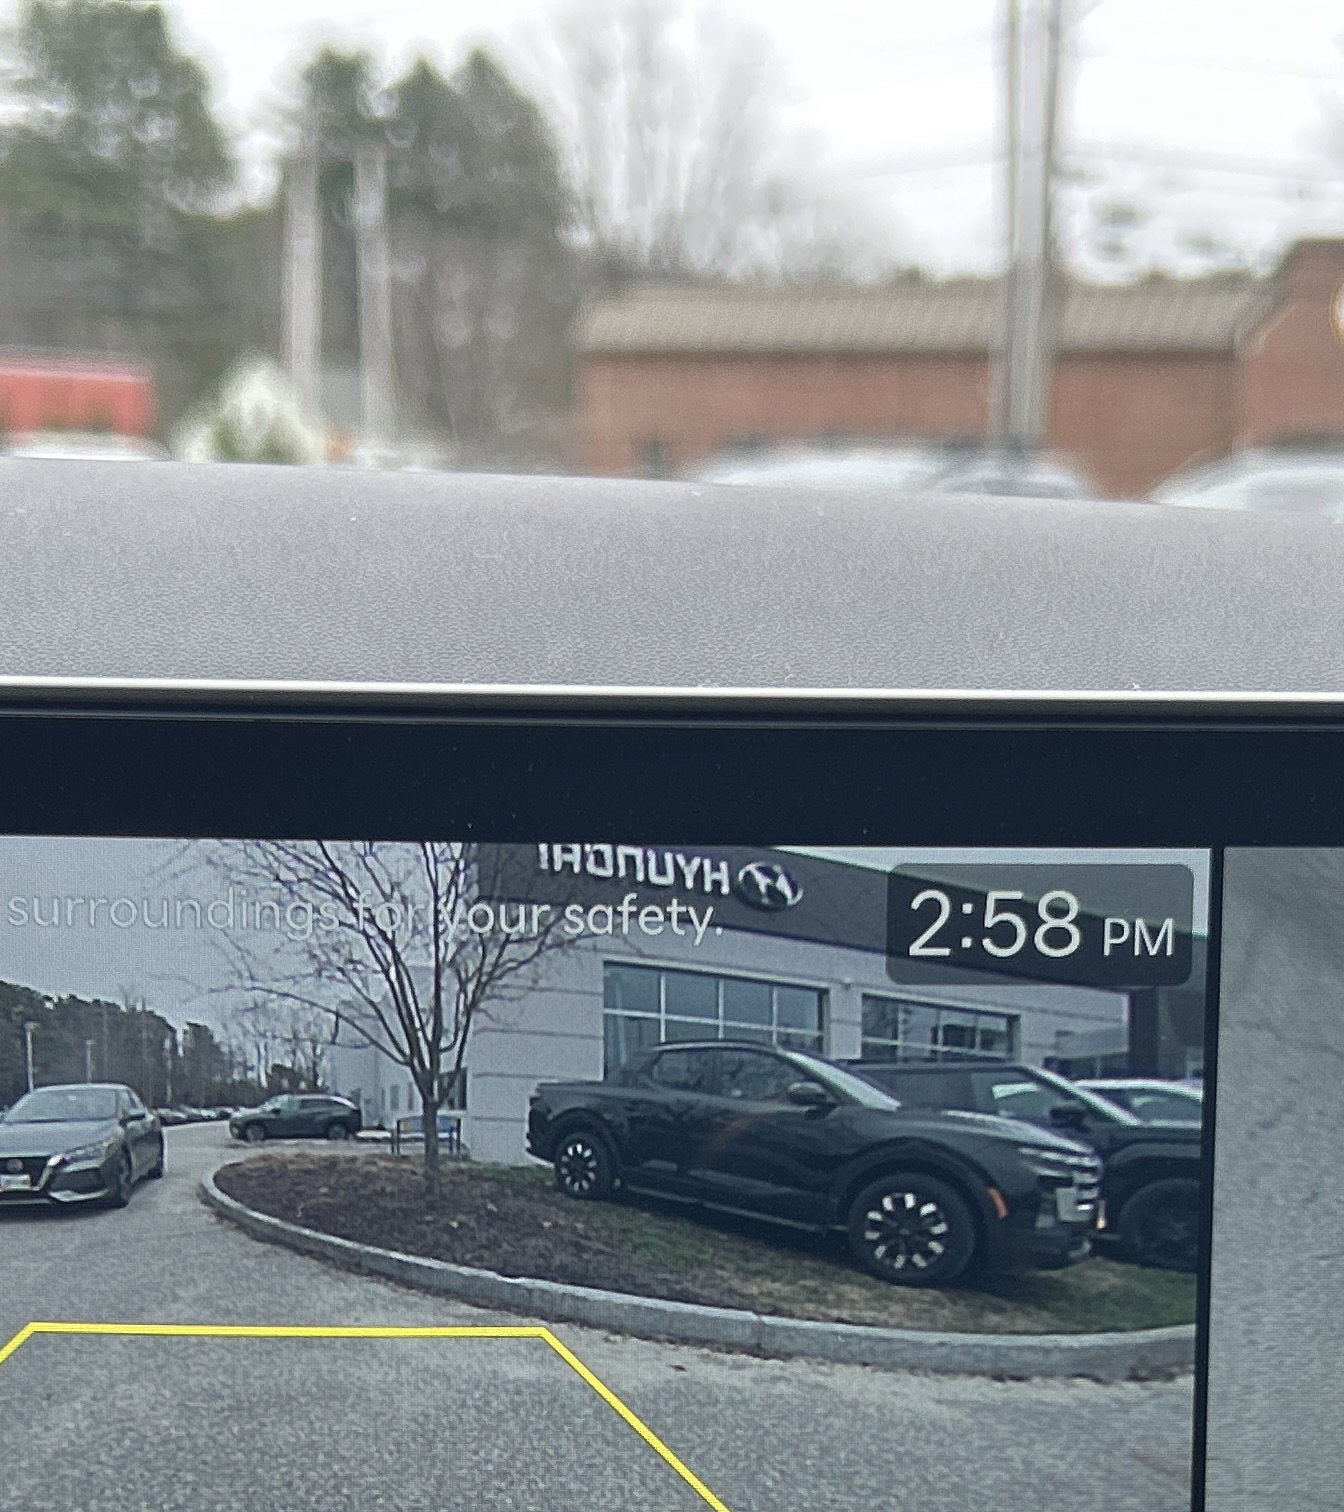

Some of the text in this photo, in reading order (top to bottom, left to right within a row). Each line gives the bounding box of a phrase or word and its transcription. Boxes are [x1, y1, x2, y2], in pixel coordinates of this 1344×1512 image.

[8, 887, 340, 941] surroundings
[356, 889, 425, 931] for
[439, 900, 550, 944] your
[564, 892, 724, 946] safety.
[909, 890, 1174, 958] 2:58 PM
